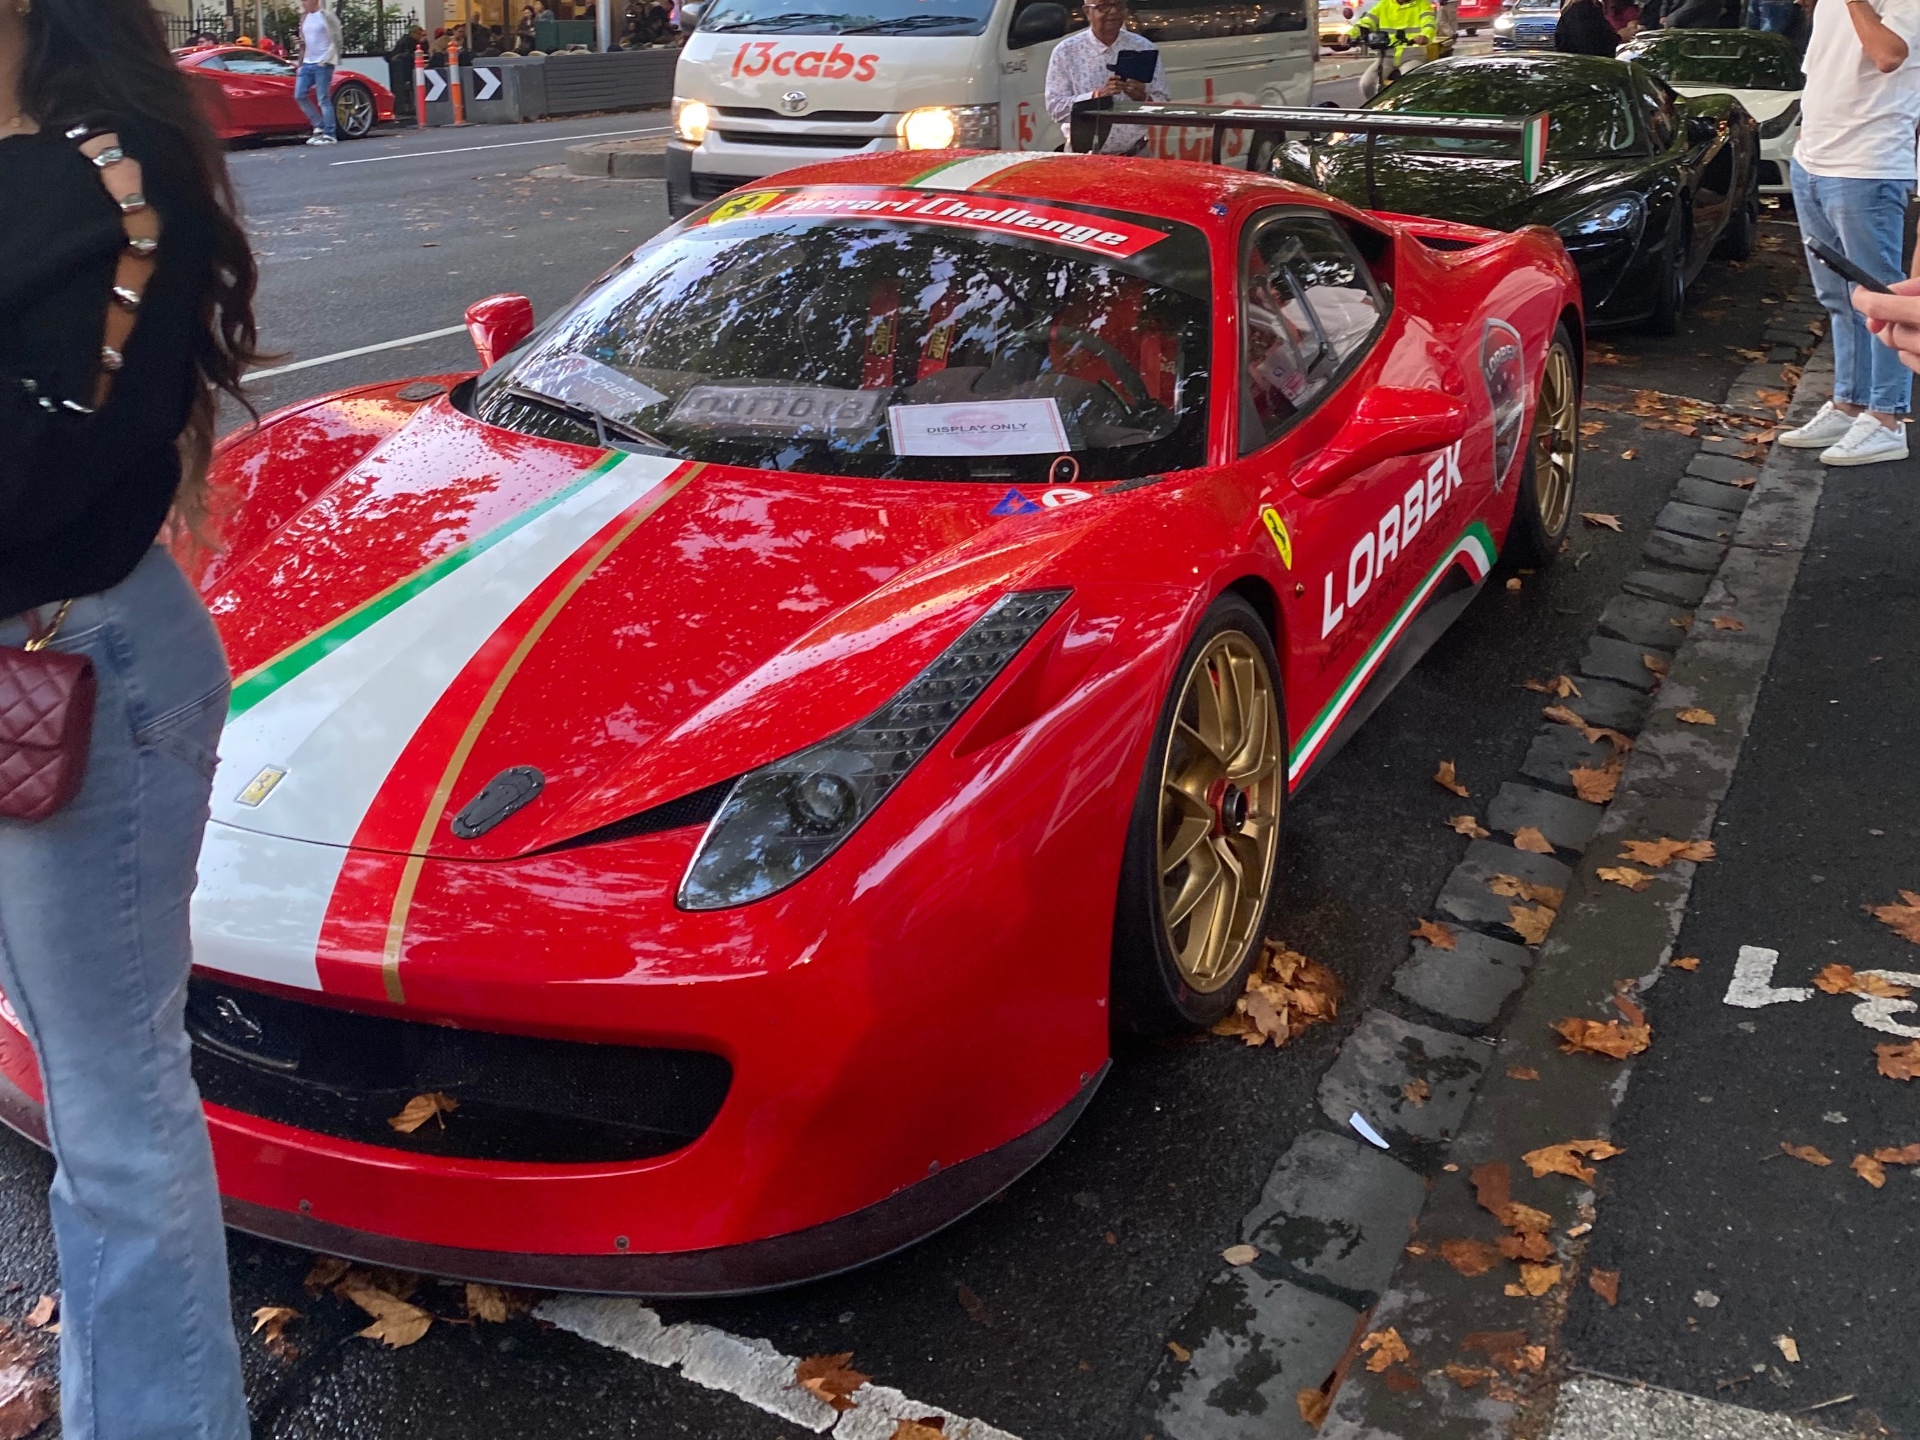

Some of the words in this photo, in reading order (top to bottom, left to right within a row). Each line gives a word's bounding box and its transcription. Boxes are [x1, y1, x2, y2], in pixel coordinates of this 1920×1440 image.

[731, 41, 880, 82] 13cabs
[766, 198, 922, 213] Ferrari
[914, 197, 1129, 246] Challenge
[582, 369, 645, 405] LORBEK
[927, 425, 986, 434] DISPLAY
[991, 422, 1028, 430] ONLY
[1321, 439, 1463, 640] LORBEK
